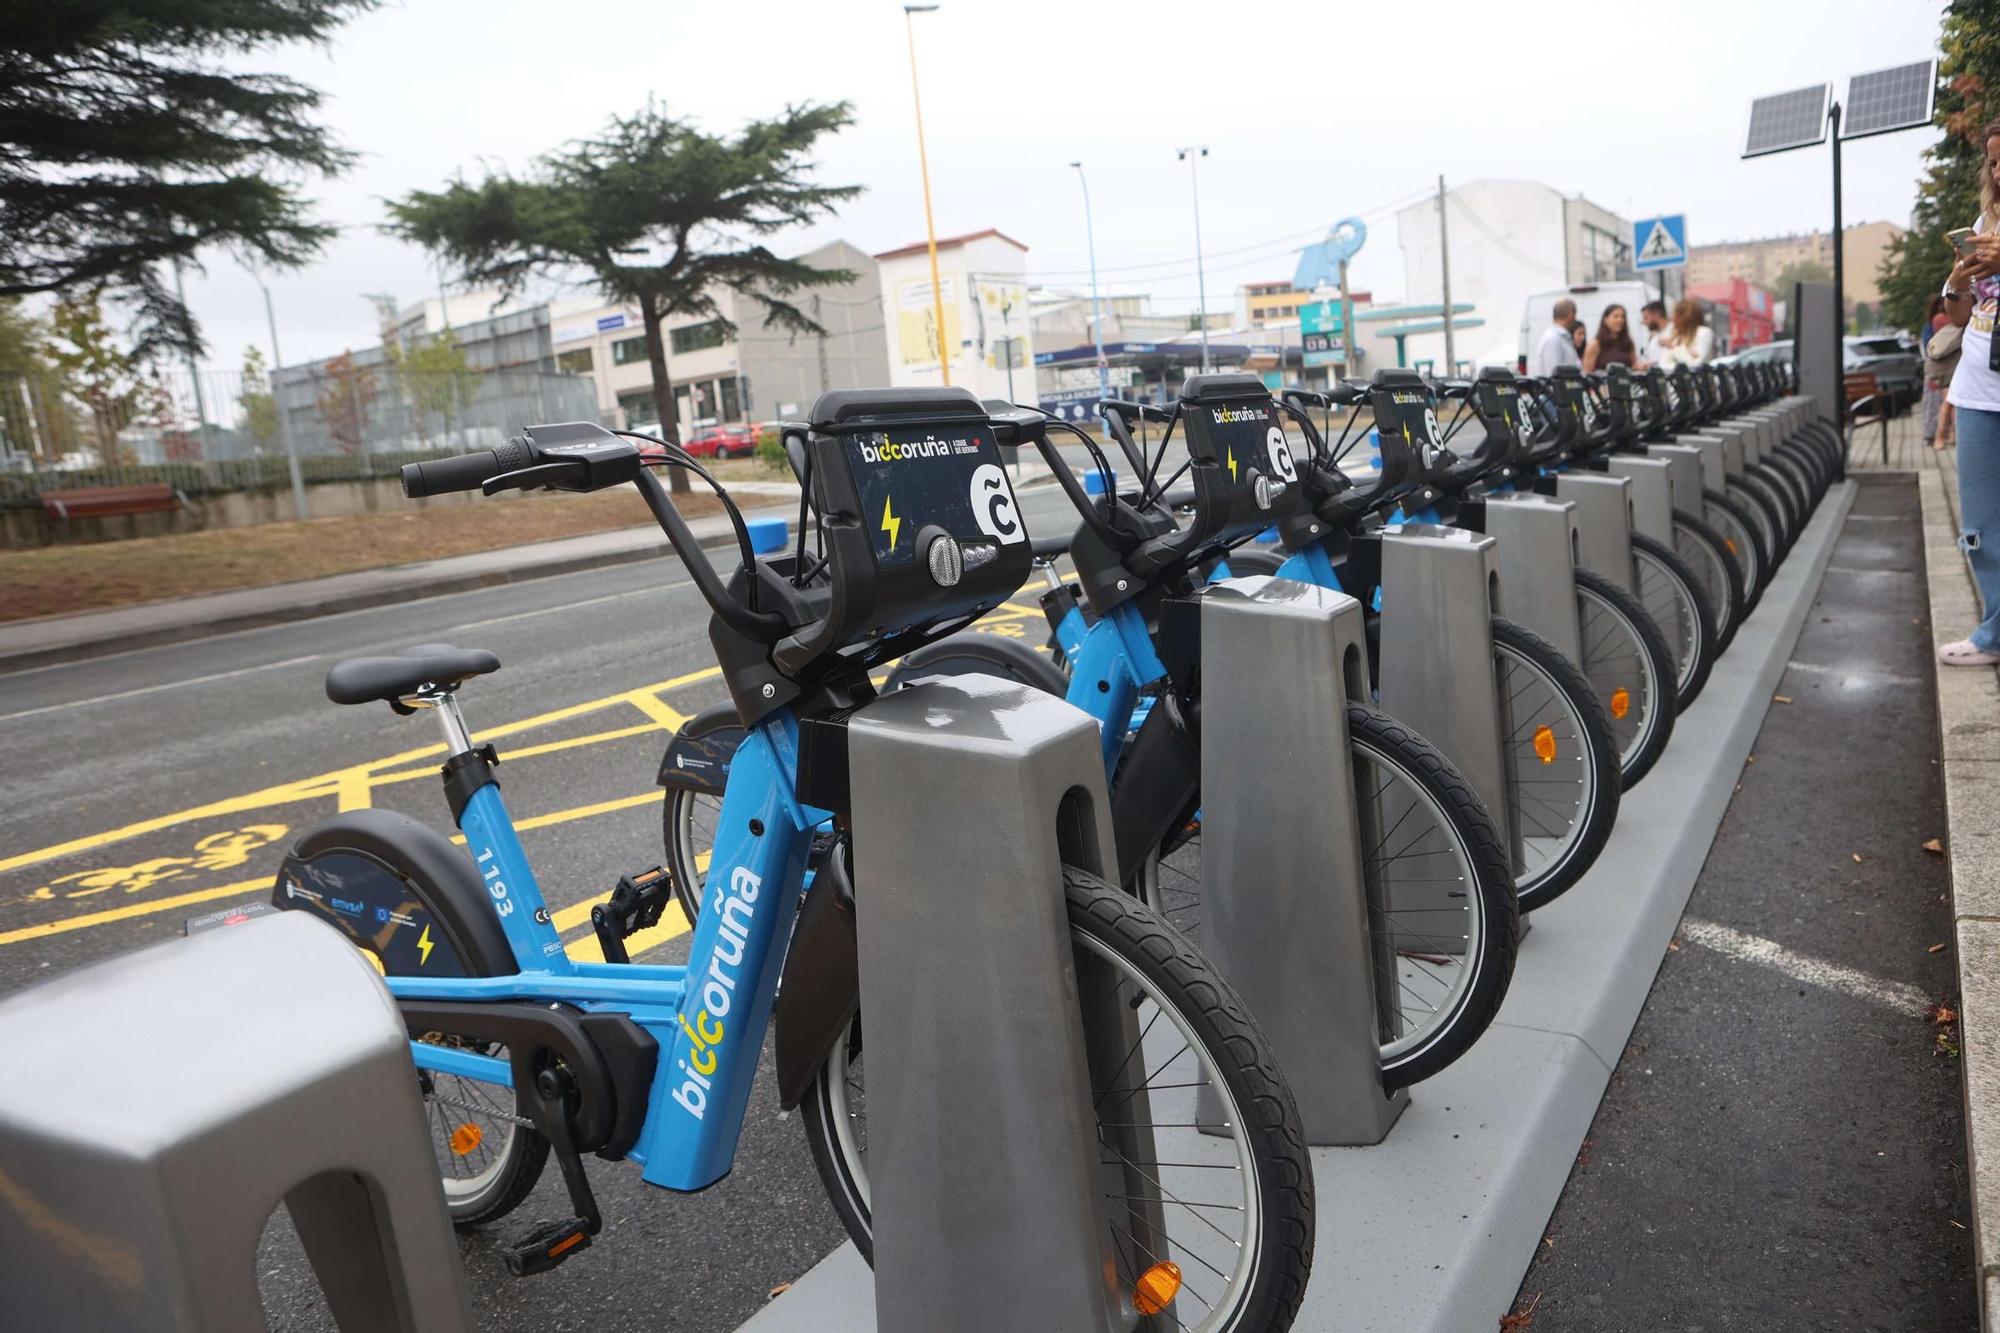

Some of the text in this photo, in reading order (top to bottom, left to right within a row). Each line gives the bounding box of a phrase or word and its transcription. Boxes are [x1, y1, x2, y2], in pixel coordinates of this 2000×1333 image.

[860, 432, 950, 463] bicicoruña
[477, 847, 514, 918] 1193
[671, 866, 762, 1121] bicicoruña
